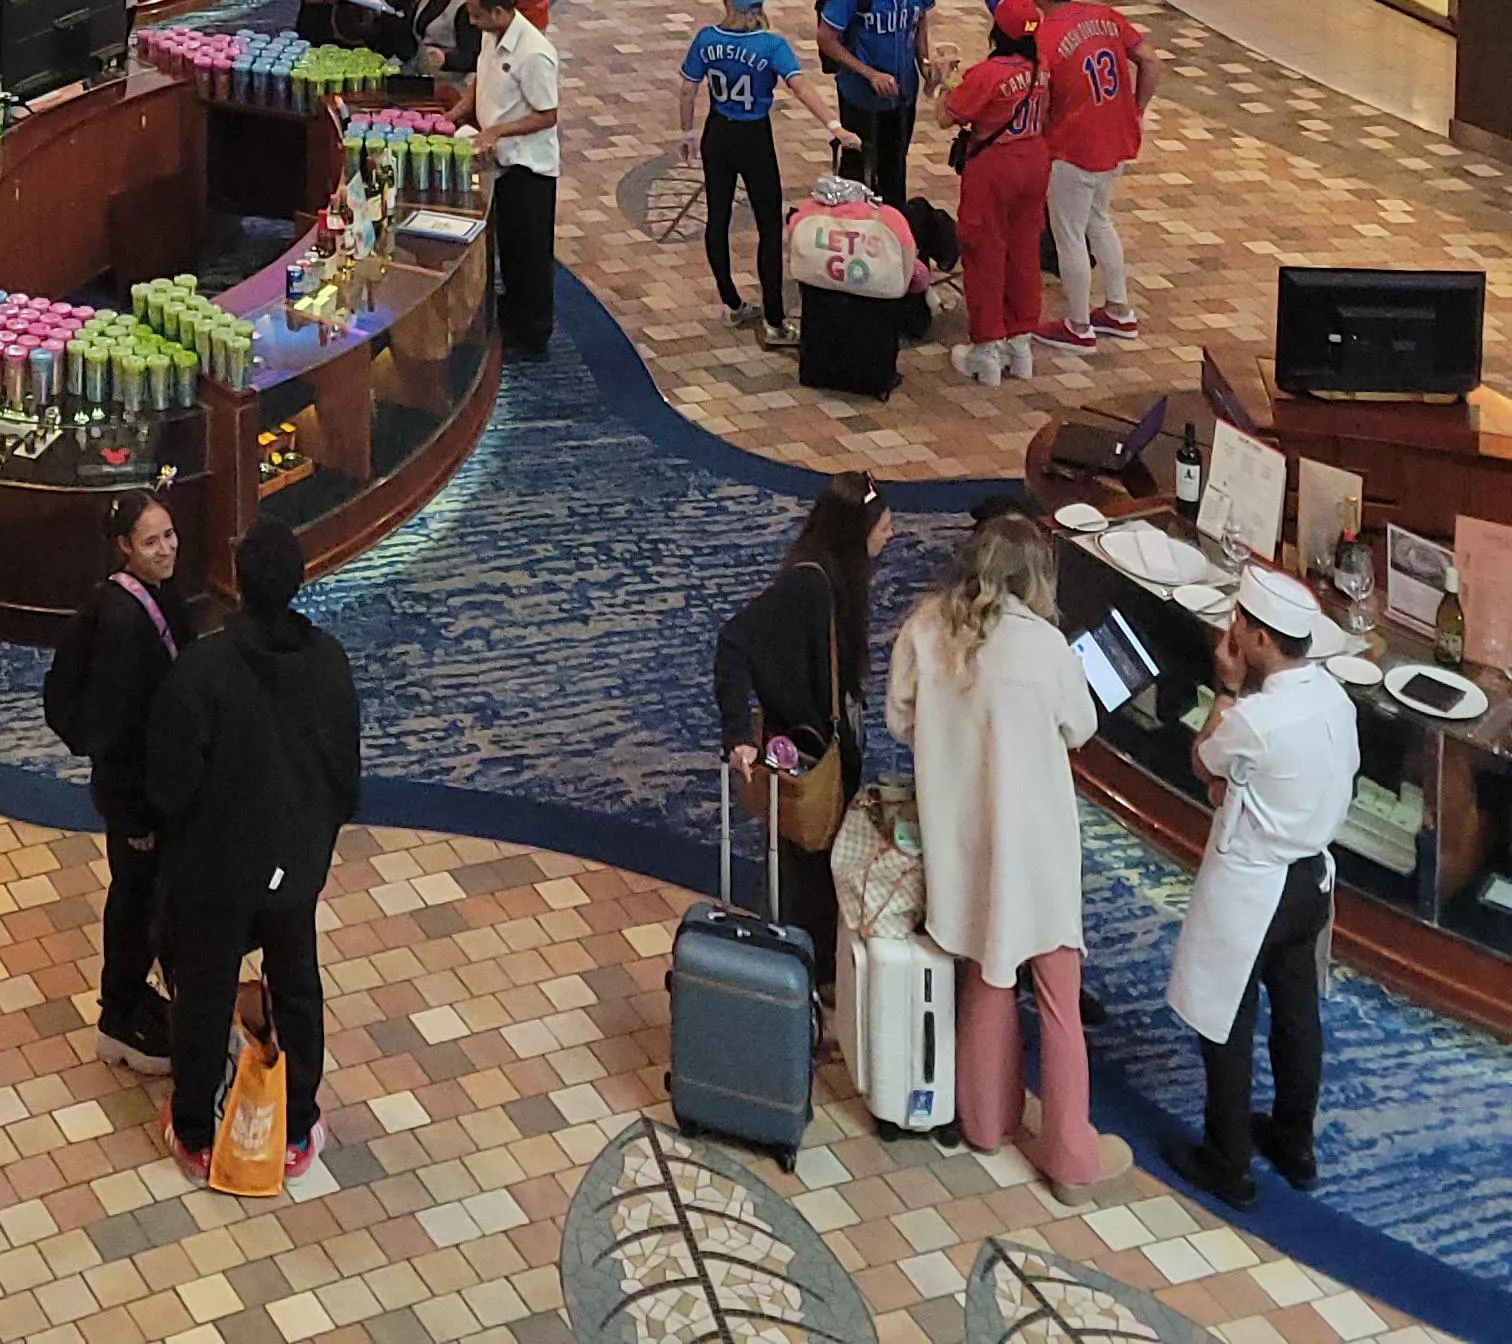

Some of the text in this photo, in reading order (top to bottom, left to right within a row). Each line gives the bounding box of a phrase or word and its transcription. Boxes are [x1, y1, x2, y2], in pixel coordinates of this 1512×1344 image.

[699, 44, 768, 72] CORSILLO
[707, 68, 754, 110] 04
[1082, 48, 1120, 106] 13
[815, 227, 881, 258] LET'S
[826, 255, 870, 283] GO
